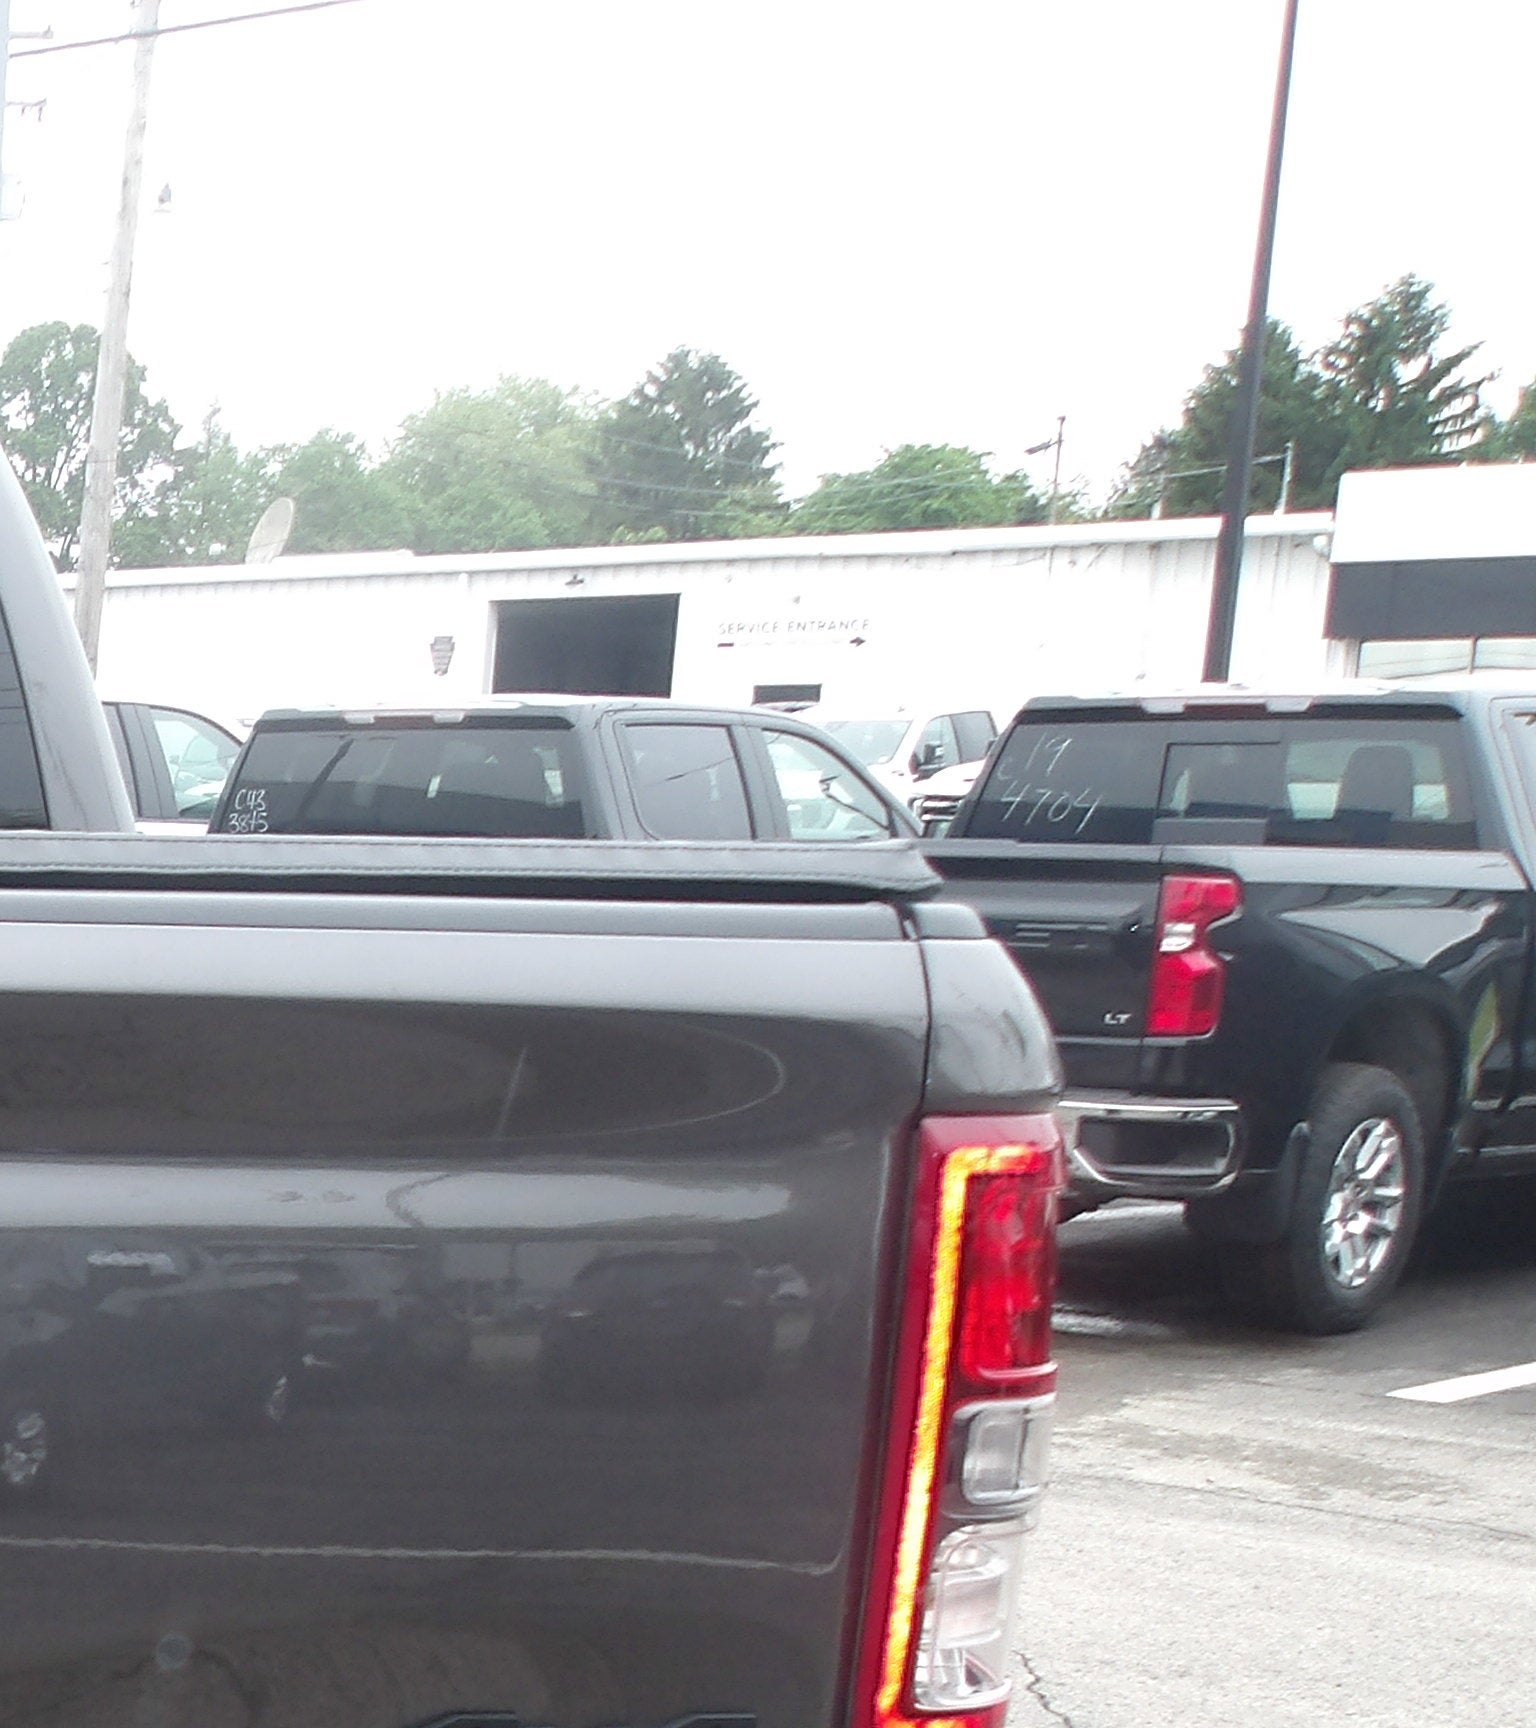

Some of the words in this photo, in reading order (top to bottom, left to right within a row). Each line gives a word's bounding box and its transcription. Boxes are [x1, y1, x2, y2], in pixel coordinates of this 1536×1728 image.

[718, 621, 779, 636] SERVICE
[787, 618, 870, 633] ENTRANCE
[234, 788, 266, 812] C43
[1000, 780, 1103, 835] 4704
[1103, 1012, 1132, 1025] LT
